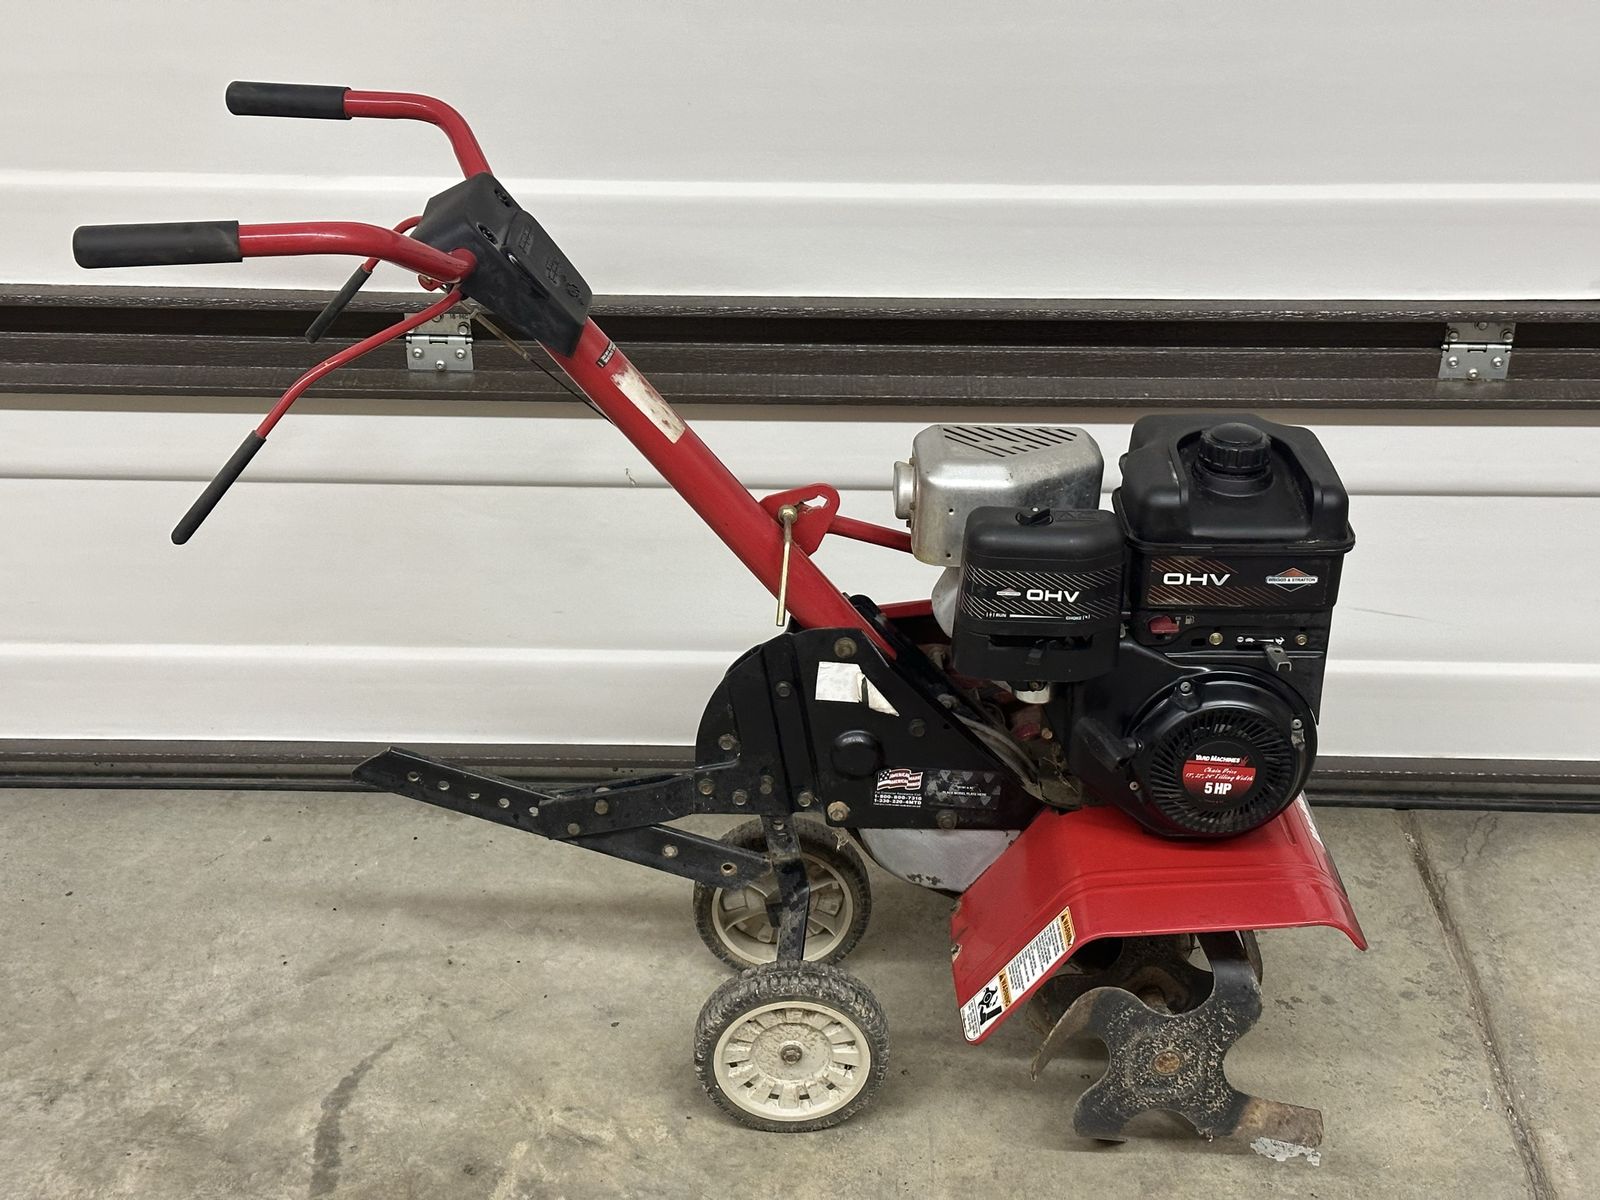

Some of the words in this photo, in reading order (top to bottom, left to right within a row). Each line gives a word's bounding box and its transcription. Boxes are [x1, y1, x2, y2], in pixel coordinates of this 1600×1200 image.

[1163, 572, 1231, 586] OHV
[1026, 589, 1080, 603] OHV
[1204, 782, 1213, 794] 5
[1213, 782, 1232, 795] HP
